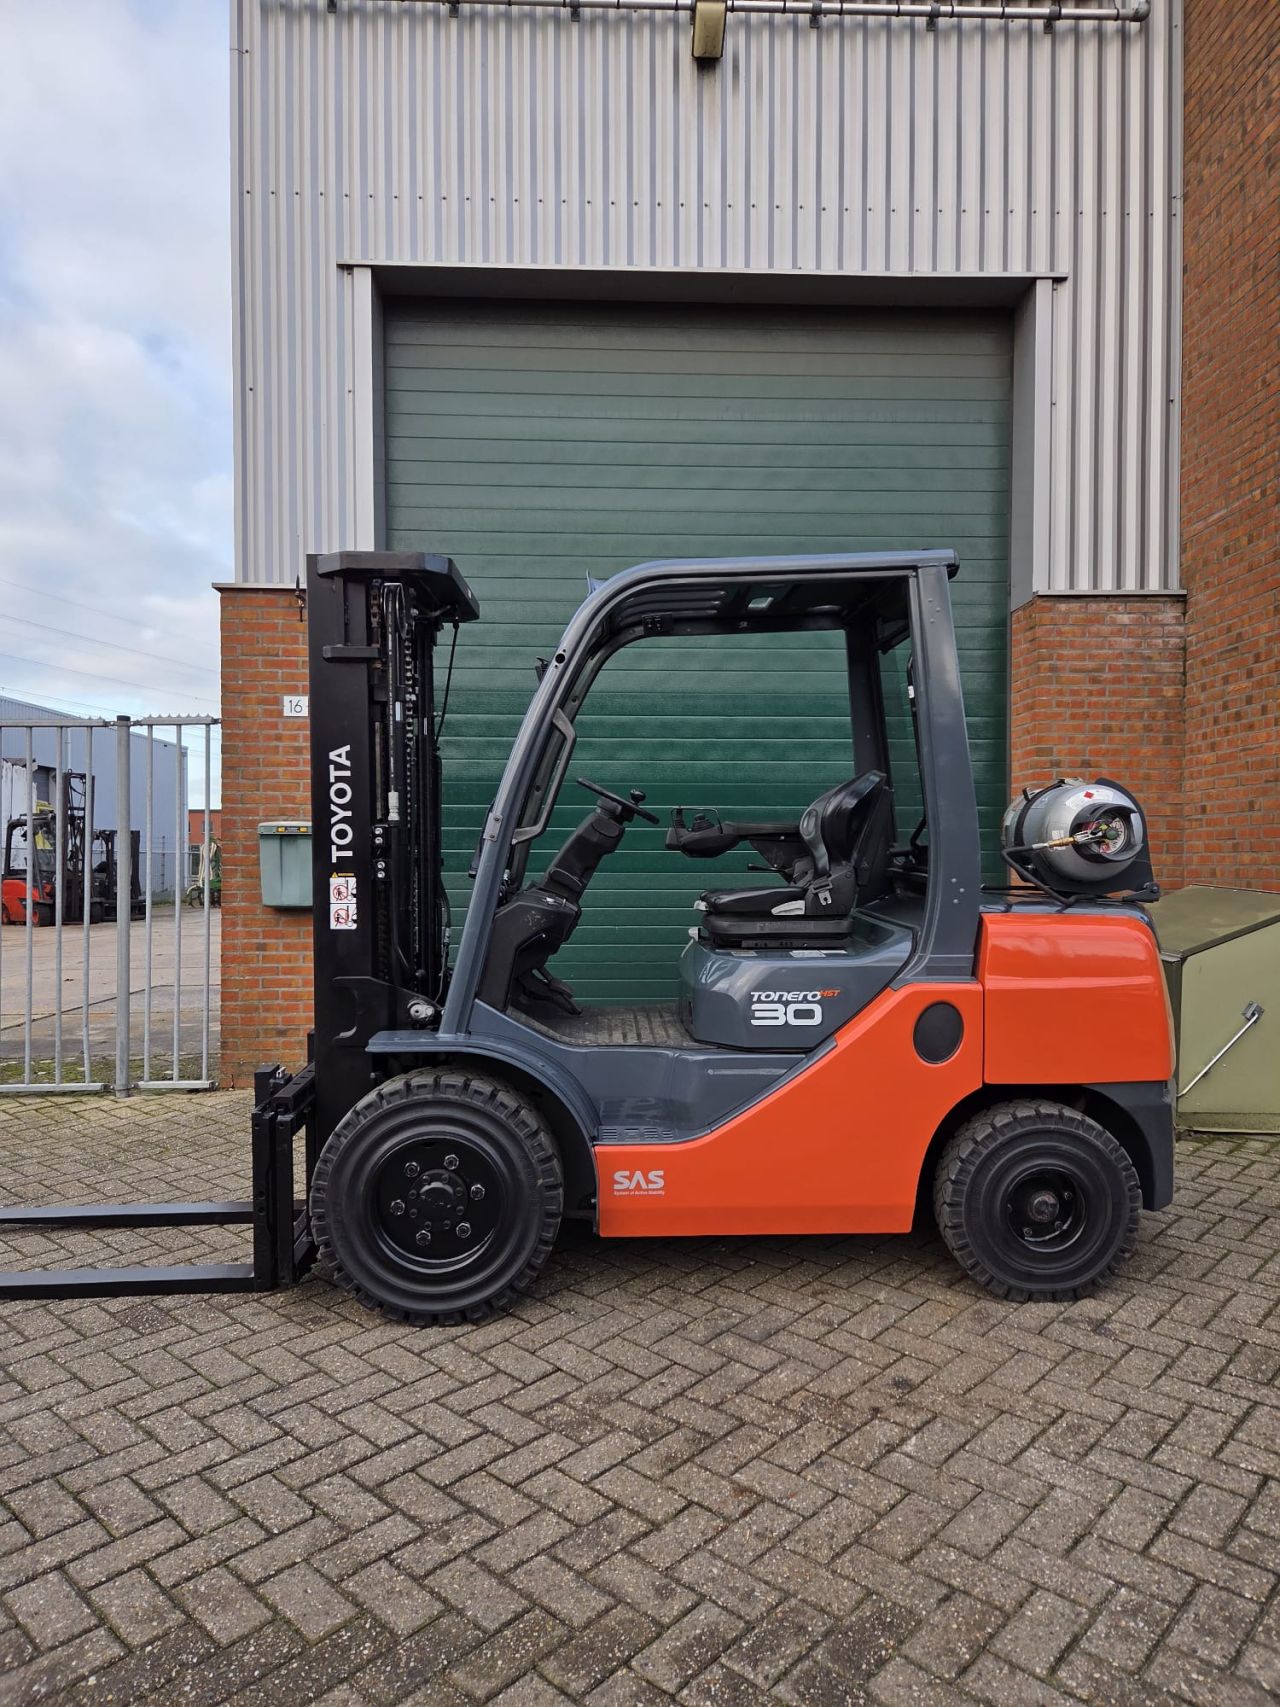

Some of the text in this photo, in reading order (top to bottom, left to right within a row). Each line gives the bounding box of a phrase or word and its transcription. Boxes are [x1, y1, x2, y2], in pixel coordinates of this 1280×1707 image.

[289, 699, 303, 713] 16
[328, 744, 353, 863] TOYOTA
[750, 1003, 822, 1026] 30
[613, 1170, 665, 1190] SAS
